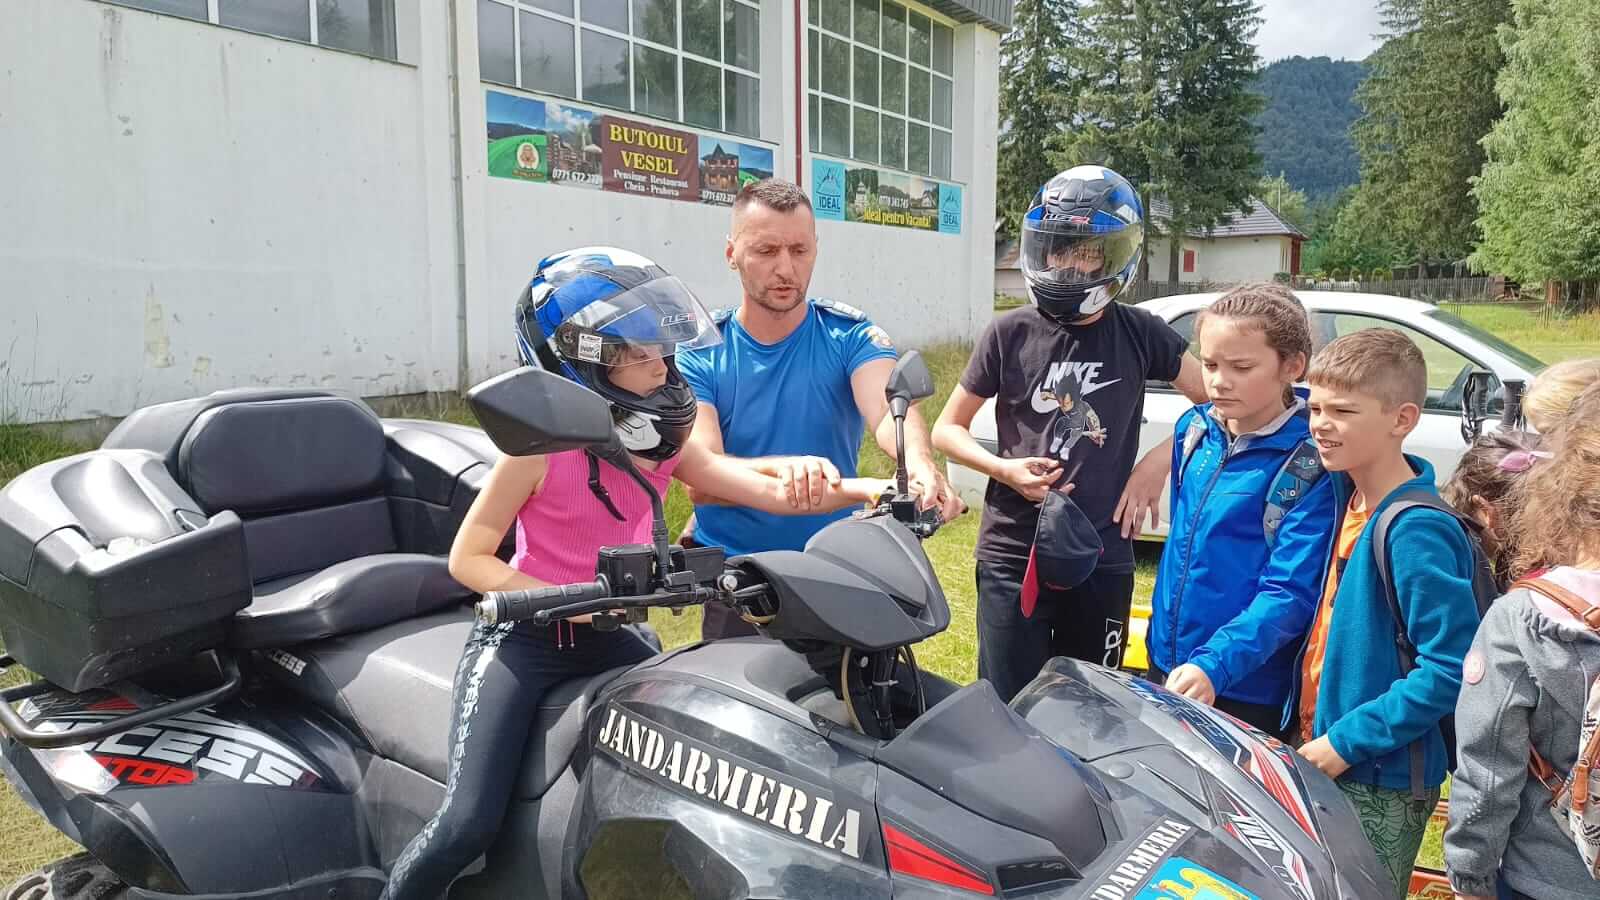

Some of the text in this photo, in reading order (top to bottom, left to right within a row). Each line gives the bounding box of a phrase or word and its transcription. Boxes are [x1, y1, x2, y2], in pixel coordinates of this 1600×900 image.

[609, 124, 687, 154] BUTOIUL
[620, 150, 678, 176] VESEL
[624, 181, 646, 193] Cheia
[650, 174, 689, 188] Restaurant
[818, 196, 841, 210] IDEAL
[881, 211, 904, 225] pentru
[943, 213, 960, 226] IDEAL
[1042, 361, 1104, 390] NIKE
[1102, 618, 1123, 671] CR7
[599, 708, 860, 859] JANDARMERIA
